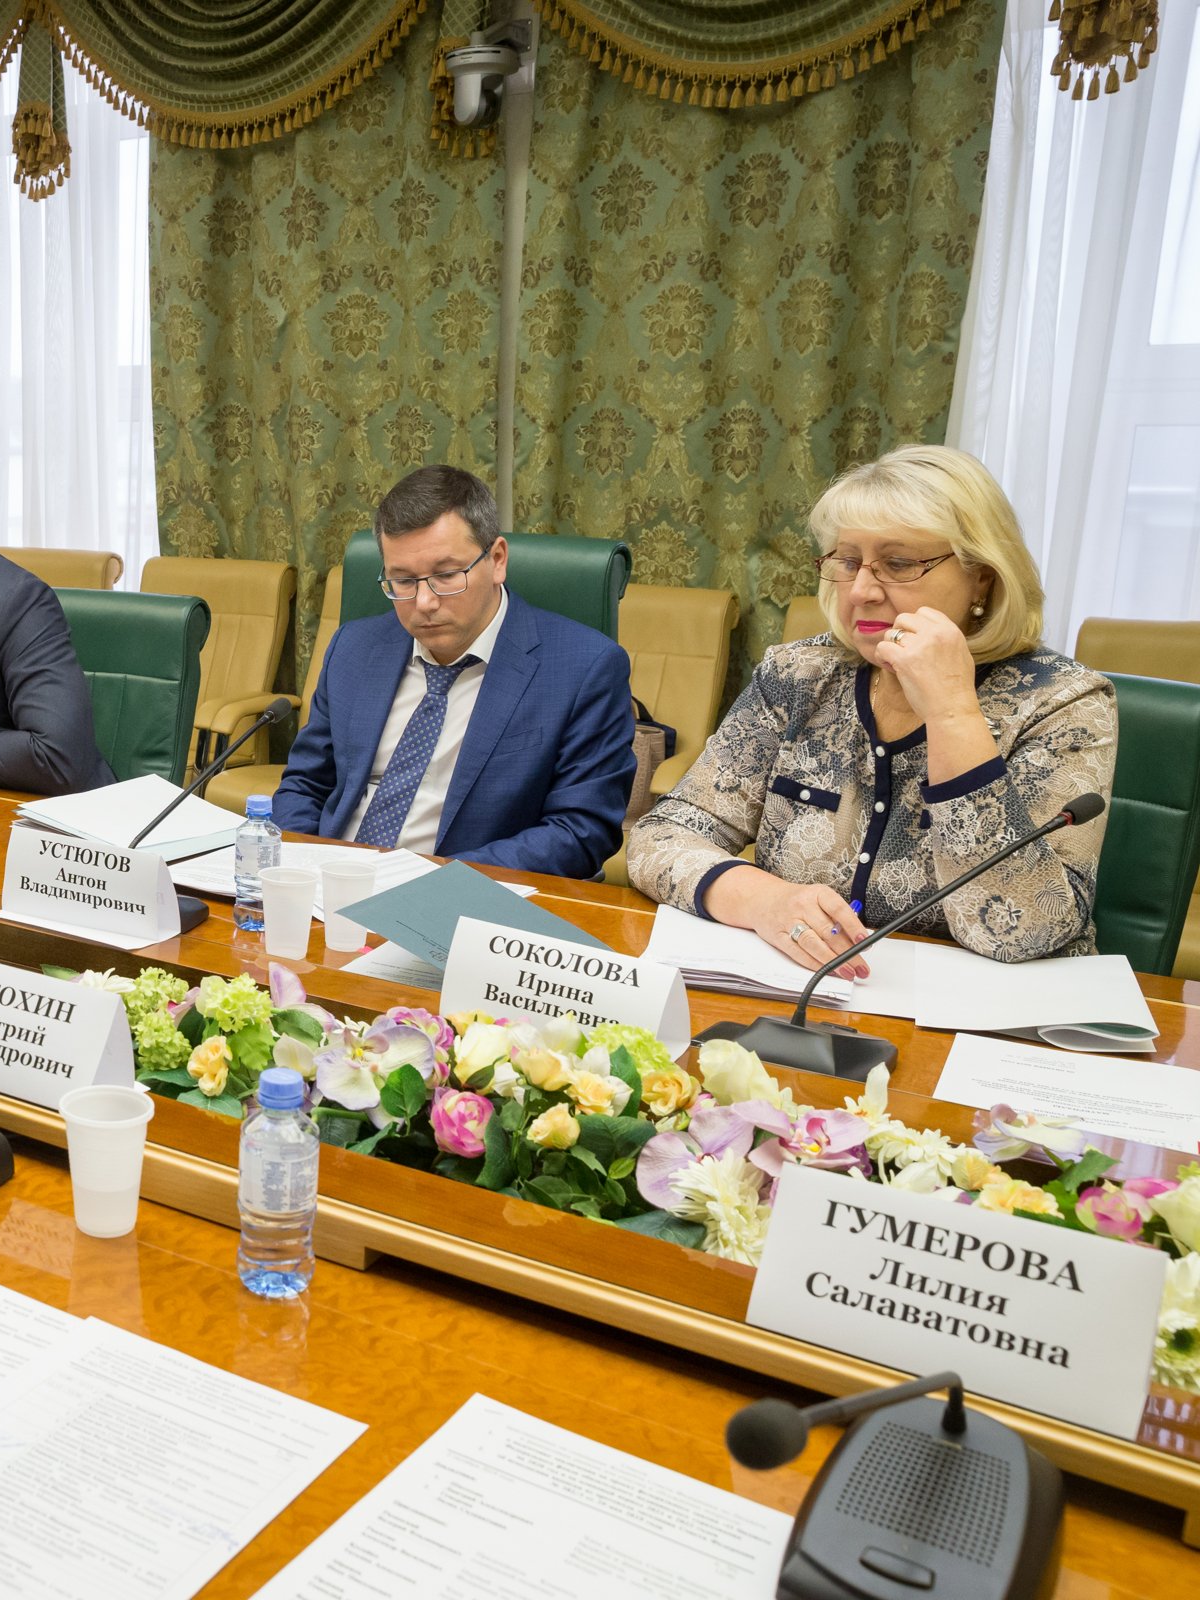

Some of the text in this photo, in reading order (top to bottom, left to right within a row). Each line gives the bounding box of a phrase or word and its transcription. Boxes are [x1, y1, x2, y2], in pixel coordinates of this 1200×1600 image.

[39, 839, 132, 874] УСТЮГОВ
[55, 866, 108, 892] Антон
[19, 875, 147, 916] Владимирович
[488, 935, 641, 988] СОКОЛОВА
[515, 969, 595, 1005] Ирина
[821, 1198, 1085, 1294] ГУМЕРОВА
[868, 1256, 1011, 1317] Лилия
[804, 1270, 1071, 1369] Салаватовна
